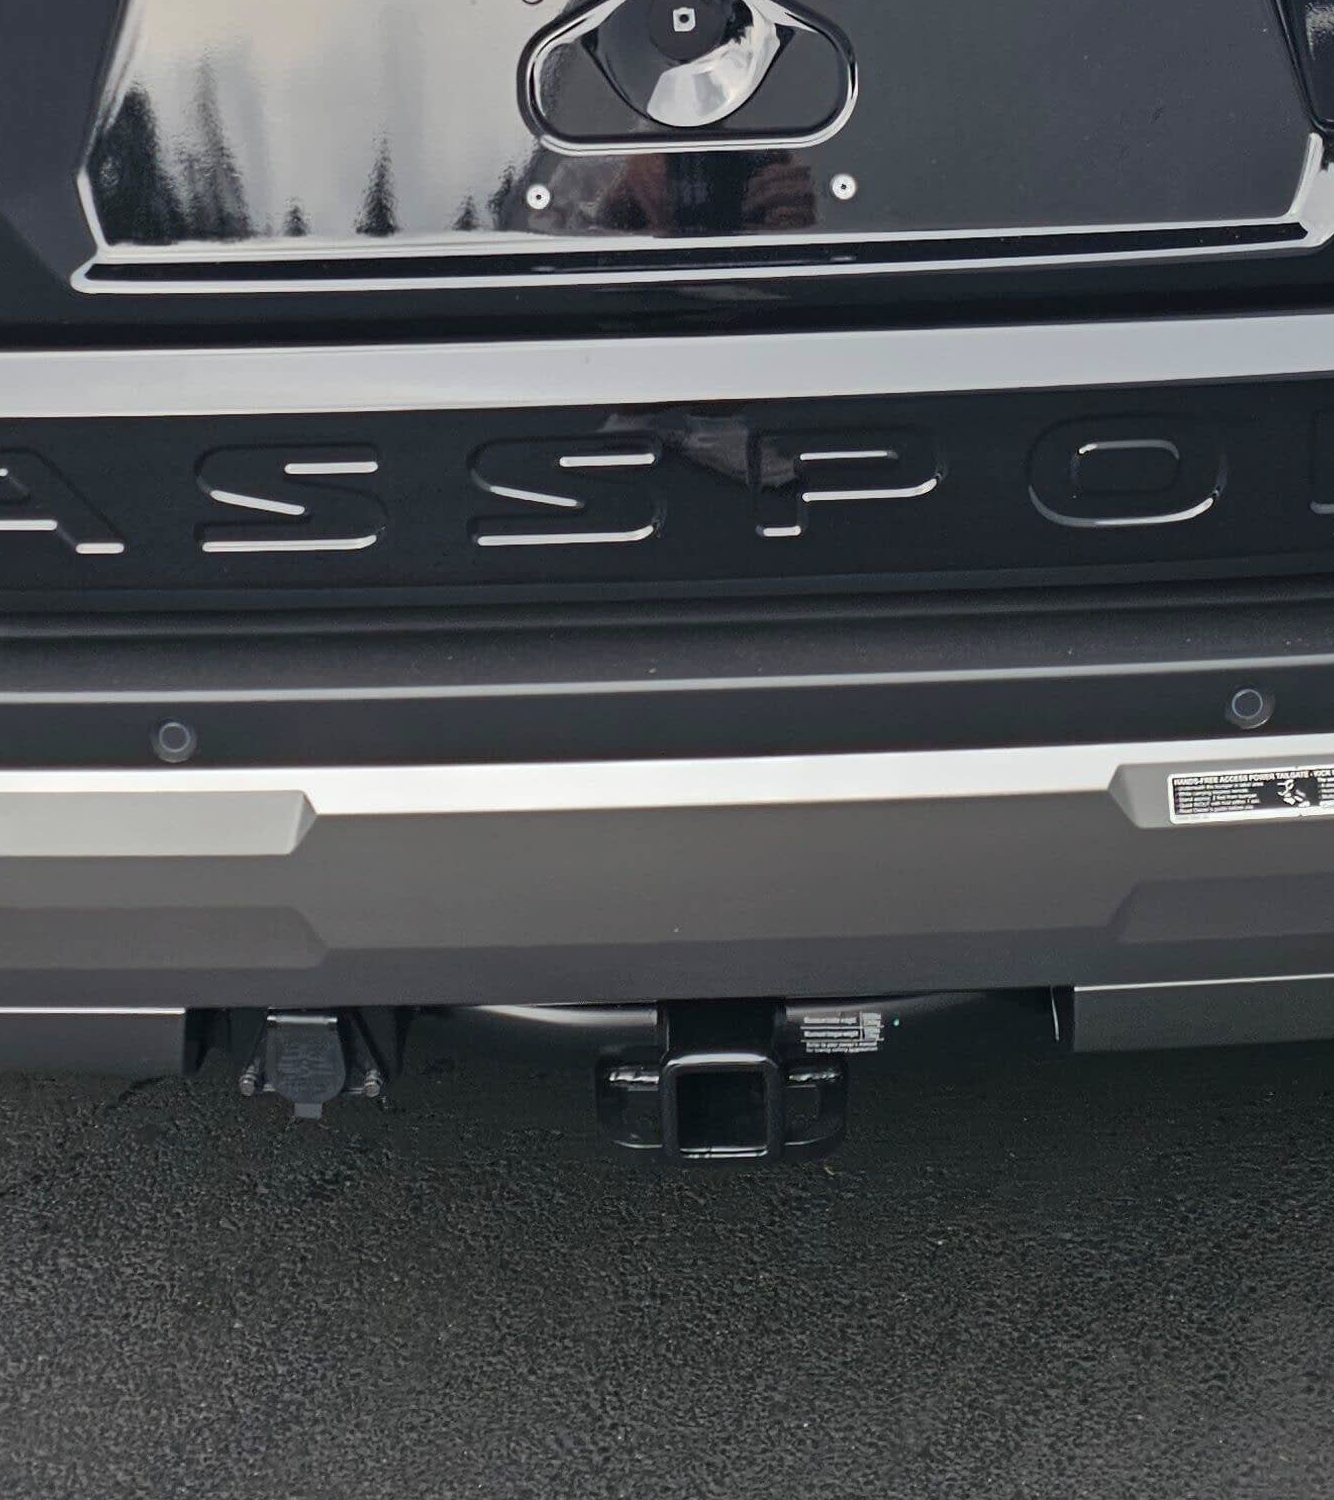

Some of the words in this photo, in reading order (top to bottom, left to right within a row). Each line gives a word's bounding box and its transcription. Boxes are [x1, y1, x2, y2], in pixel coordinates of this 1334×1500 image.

[1219, 774, 1248, 784] ACCESS
[1249, 772, 1275, 782] POWER
[1275, 770, 1309, 780] TAILGATE
